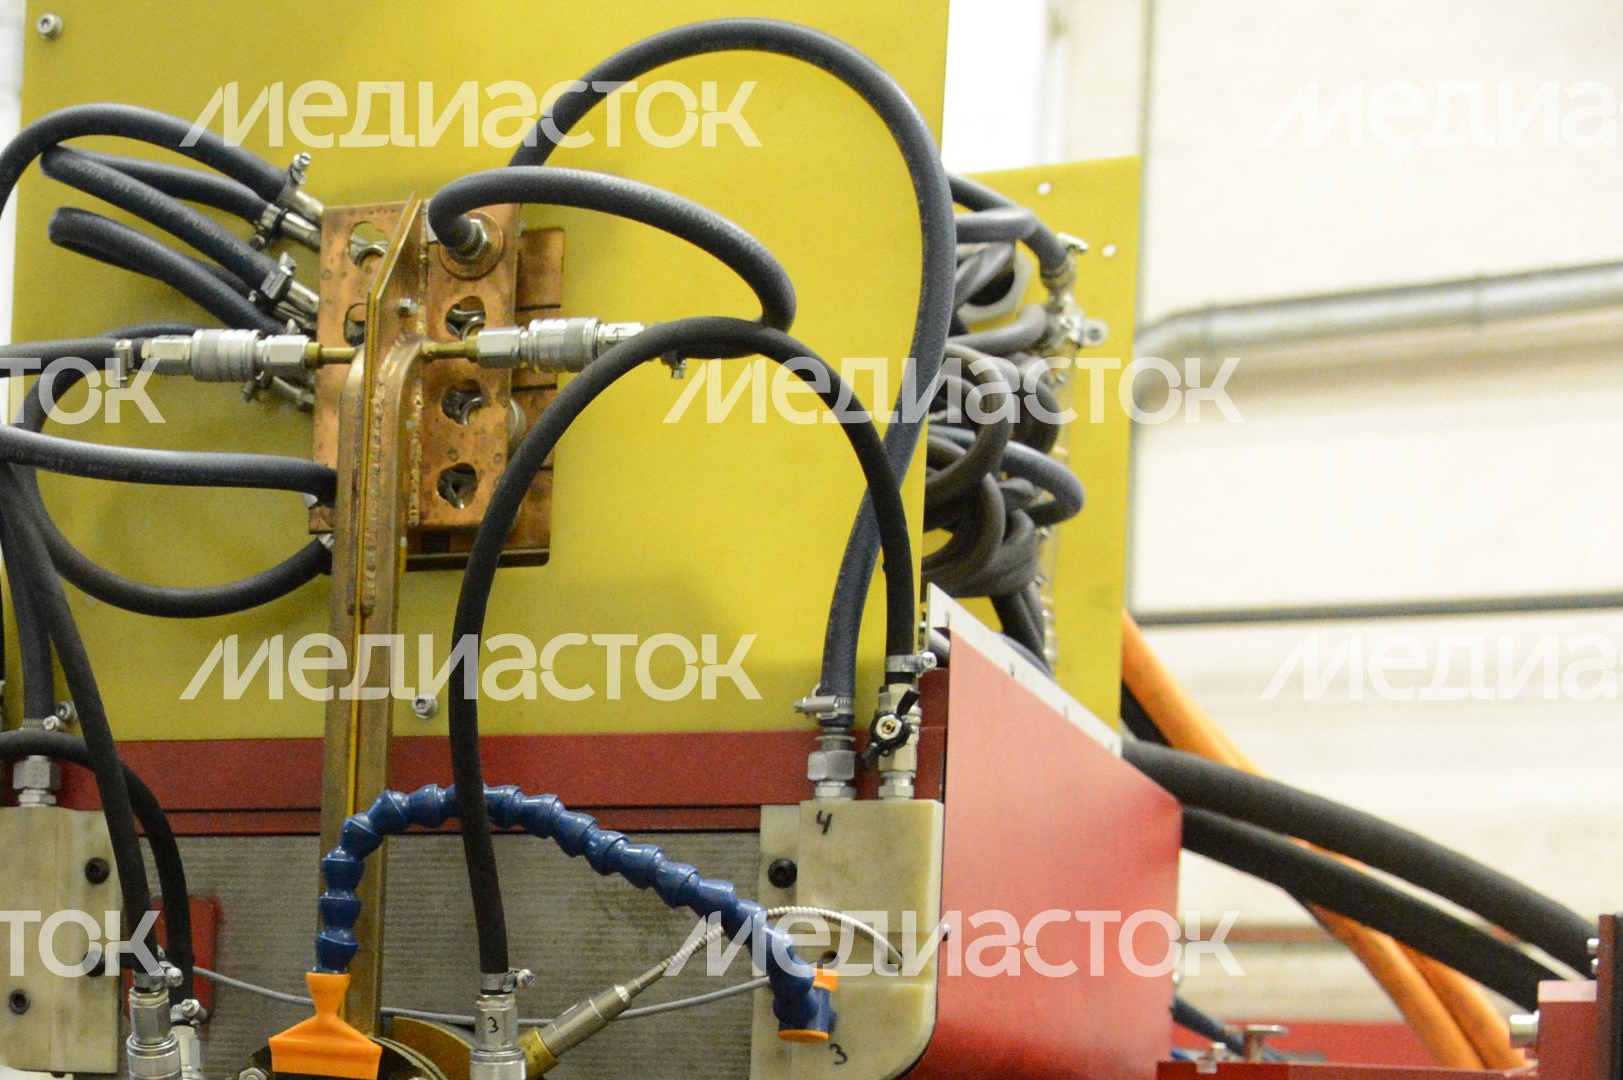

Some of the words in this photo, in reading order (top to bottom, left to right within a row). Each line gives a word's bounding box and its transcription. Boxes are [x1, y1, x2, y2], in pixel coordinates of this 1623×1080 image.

[815, 810, 833, 834] 4
[487, 1016, 499, 1034] 3
[829, 1043, 849, 1065] 3
